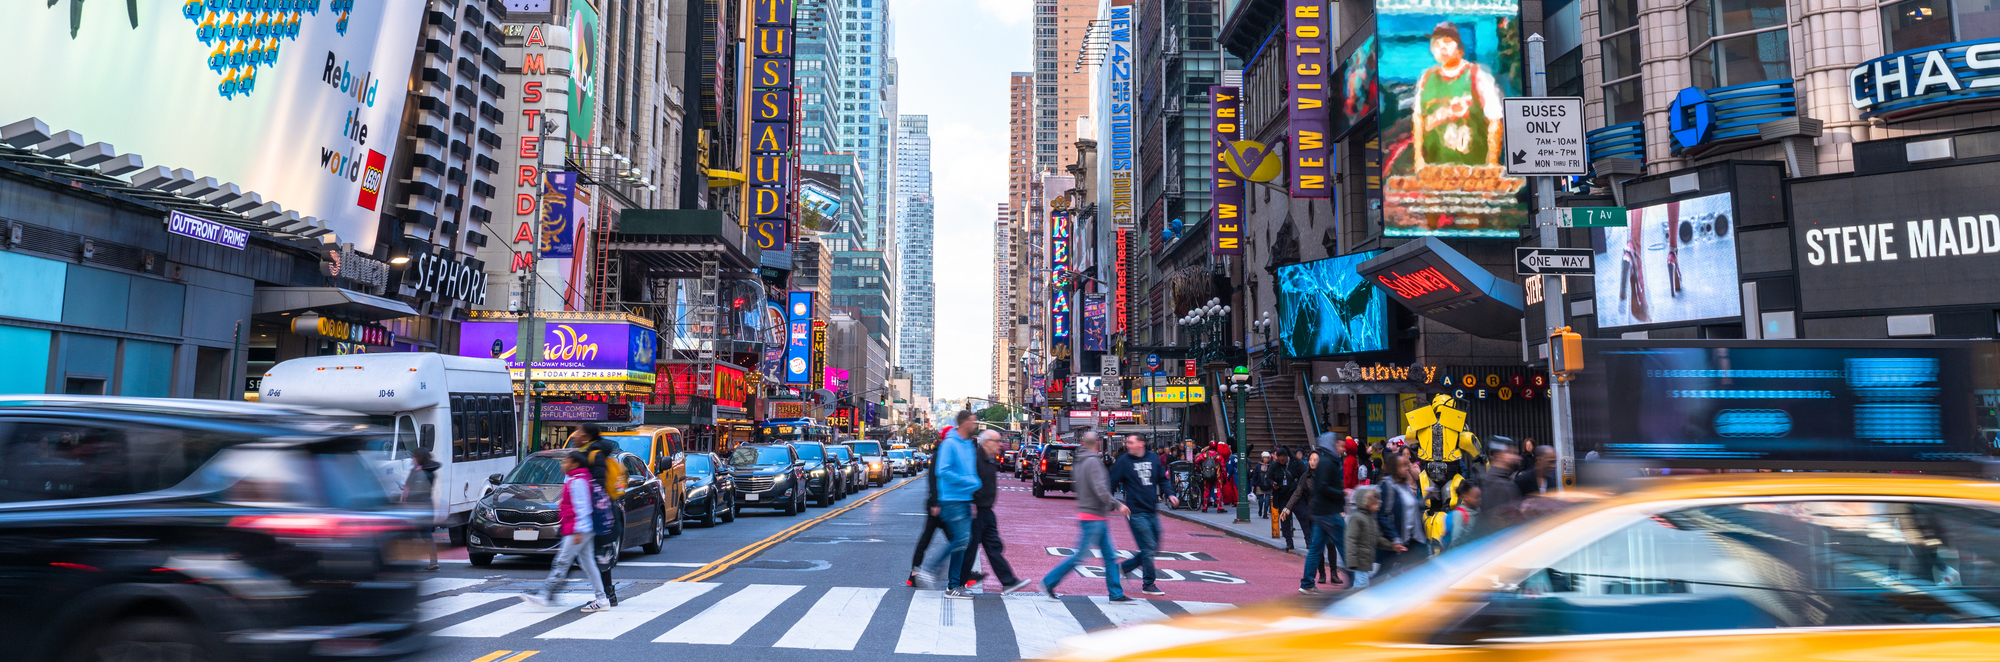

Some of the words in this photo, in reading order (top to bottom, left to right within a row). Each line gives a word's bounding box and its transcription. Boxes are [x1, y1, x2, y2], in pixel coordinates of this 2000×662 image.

[1111, 8, 1130, 42] NEW
[1295, 5, 1322, 110] VICTOR
[322, 50, 379, 108] Rebuild
[570, 62, 593, 97] ALDO
[1850, 42, 2000, 110] CHAS
[343, 107, 368, 145] the
[754, 0, 785, 249] TUSSAUD'S
[1522, 105, 1566, 117] BUSES
[1526, 121, 1561, 133] ONLY
[511, 25, 546, 273] AMSTERDAM
[1112, 103, 1131, 170] STUDIOS
[320, 146, 364, 183] world
[1299, 130, 1325, 189] NEW
[362, 167, 382, 194] LEGO
[1113, 178, 1131, 217] DUKE
[172, 214, 220, 240] OUTFRONT
[222, 228, 246, 247] PRIME
[1218, 203, 1239, 249] NEW
[1586, 210, 1594, 225] 7
[1806, 223, 1898, 266] STEVE
[1906, 213, 2000, 259] MADD
[1052, 216, 1069, 337] REGAL
[1528, 256, 1551, 267] ONE
[1561, 256, 1585, 267] WAY
[415, 252, 488, 306] SEPHORA
[1377, 266, 1461, 299] Subway
[1525, 274, 1543, 305] STEVE
[792, 323, 807, 333] EAT.
[814, 332, 823, 389] EMPIRE
[1103, 367, 1117, 375] 25
[267, 388, 281, 397] JD-66
[378, 389, 395, 398] JD-66
[1168, 376, 1200, 385] VICTRY
[1179, 391, 1202, 399] Fbles
[1443, 376, 1452, 385] A
[1465, 376, 1474, 386] Q
[1489, 376, 1498, 385] R
[1535, 376, 1543, 386] 3
[1455, 389, 1464, 399] C
[1478, 389, 1486, 398] E
[1500, 389, 1510, 398] W
[1074, 564, 1247, 584] BUS
